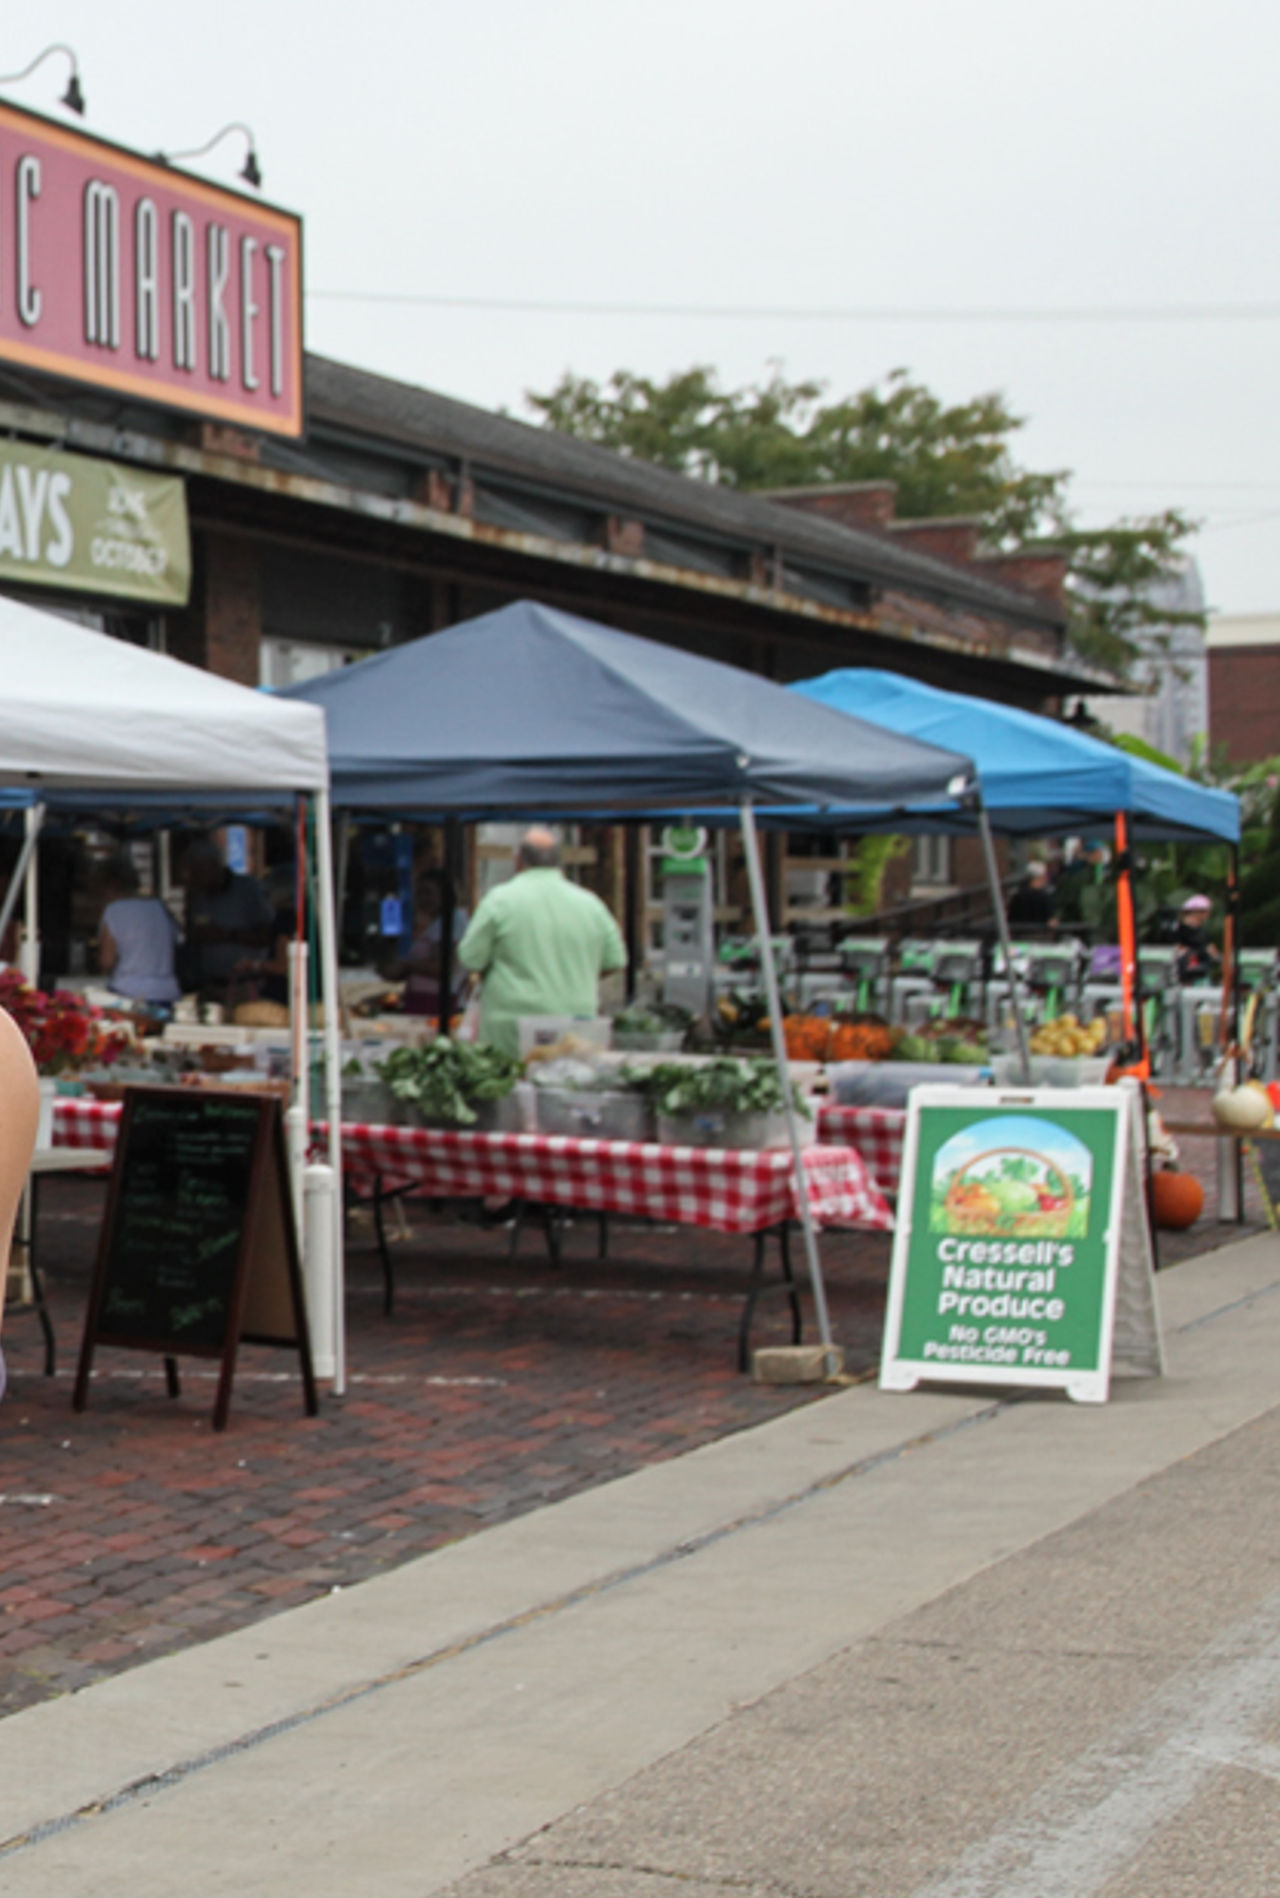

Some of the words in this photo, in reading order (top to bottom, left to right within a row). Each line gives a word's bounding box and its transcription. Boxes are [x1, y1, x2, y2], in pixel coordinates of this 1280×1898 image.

[81, 179, 286, 398] MARKET
[938, 1239, 1075, 1267] Cressell's
[943, 1265, 1055, 1291] Natural
[939, 1291, 1065, 1320] Produce
[950, 1325, 978, 1342] No
[984, 1327, 1047, 1345] GMO's
[923, 1341, 1017, 1364] Pesticide
[1023, 1347, 1071, 1366] Free
